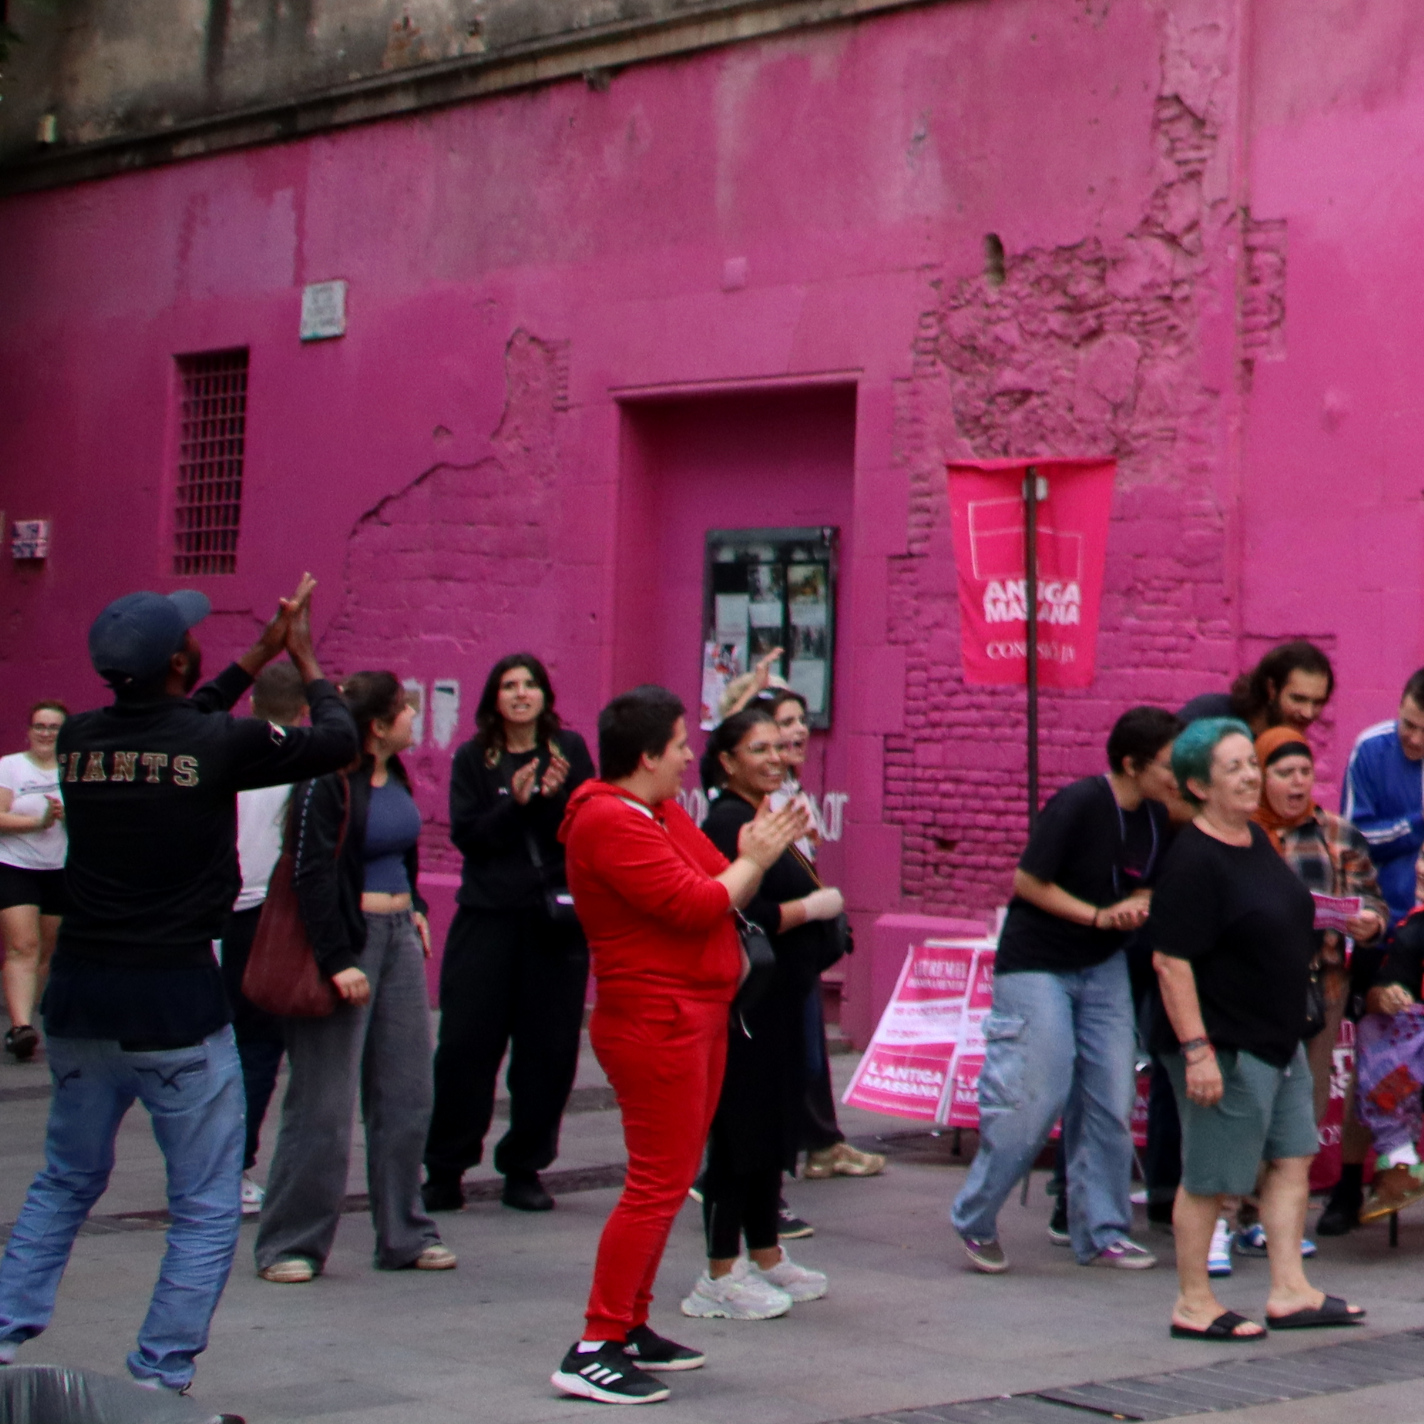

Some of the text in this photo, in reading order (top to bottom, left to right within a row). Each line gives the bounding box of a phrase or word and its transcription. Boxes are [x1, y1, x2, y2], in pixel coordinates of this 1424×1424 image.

[983, 580, 1082, 605] ANIGA
[984, 599, 1080, 624] MAANA
[861, 1074, 940, 1098] MASSANA
